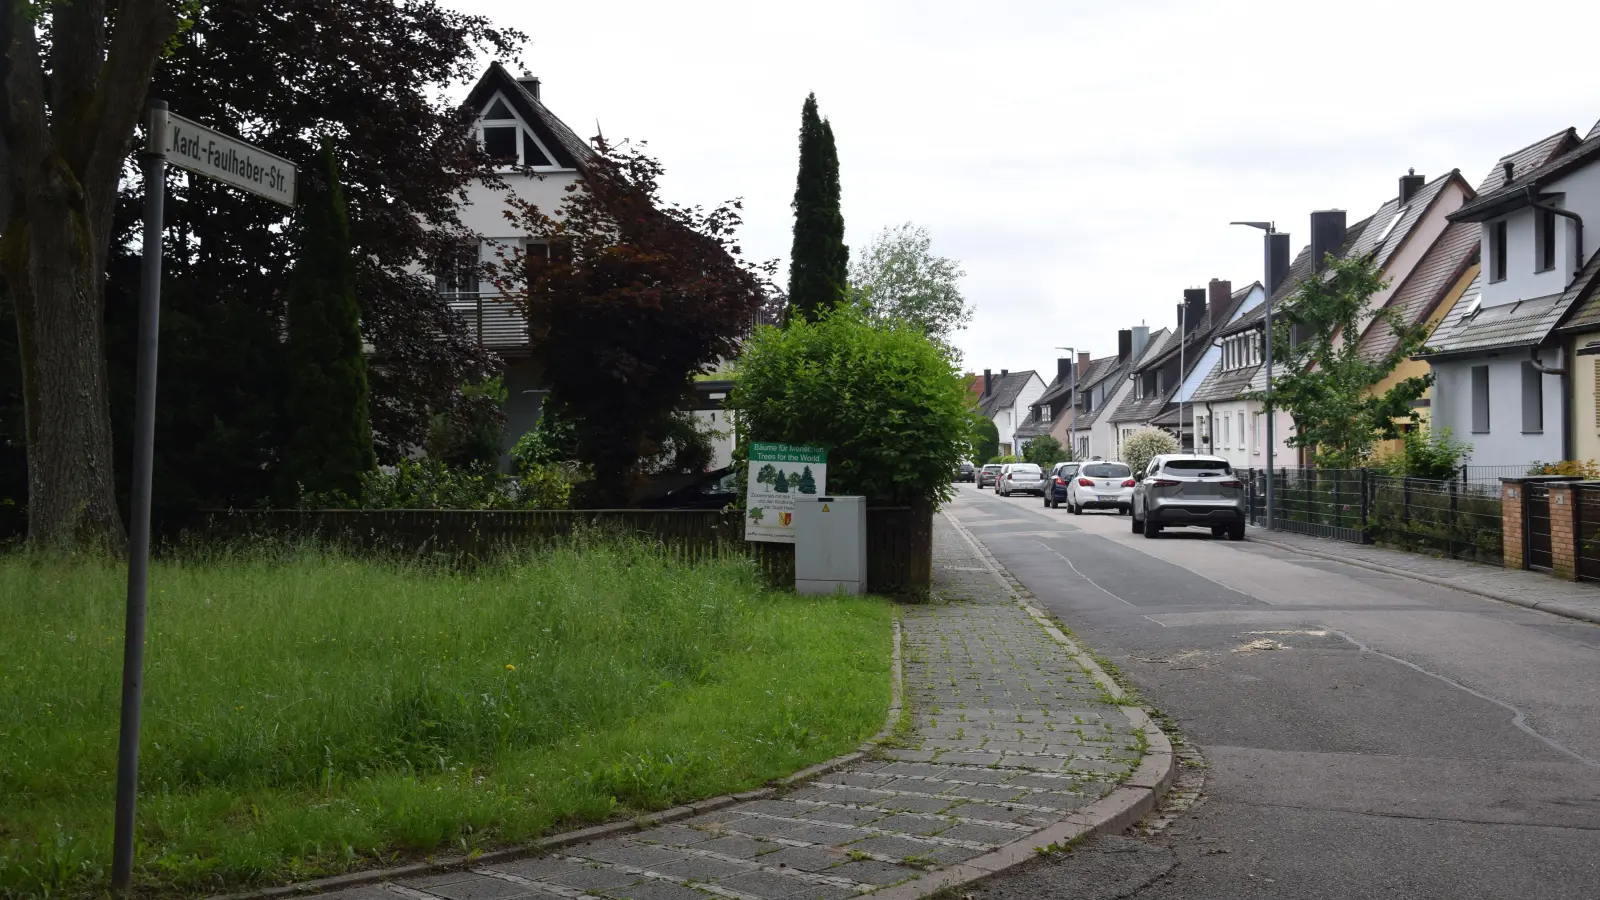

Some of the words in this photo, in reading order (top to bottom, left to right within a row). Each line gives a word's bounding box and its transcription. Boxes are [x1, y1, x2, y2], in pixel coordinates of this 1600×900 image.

[173, 126, 287, 194] Kard.-Faulhaber-Str.
[711, 412, 715, 422] 1
[754, 443, 778, 452] Bäume
[779, 444, 788, 452] für
[757, 452, 776, 460] Trees
[777, 453, 786, 461] for
[800, 454, 820, 462] World
